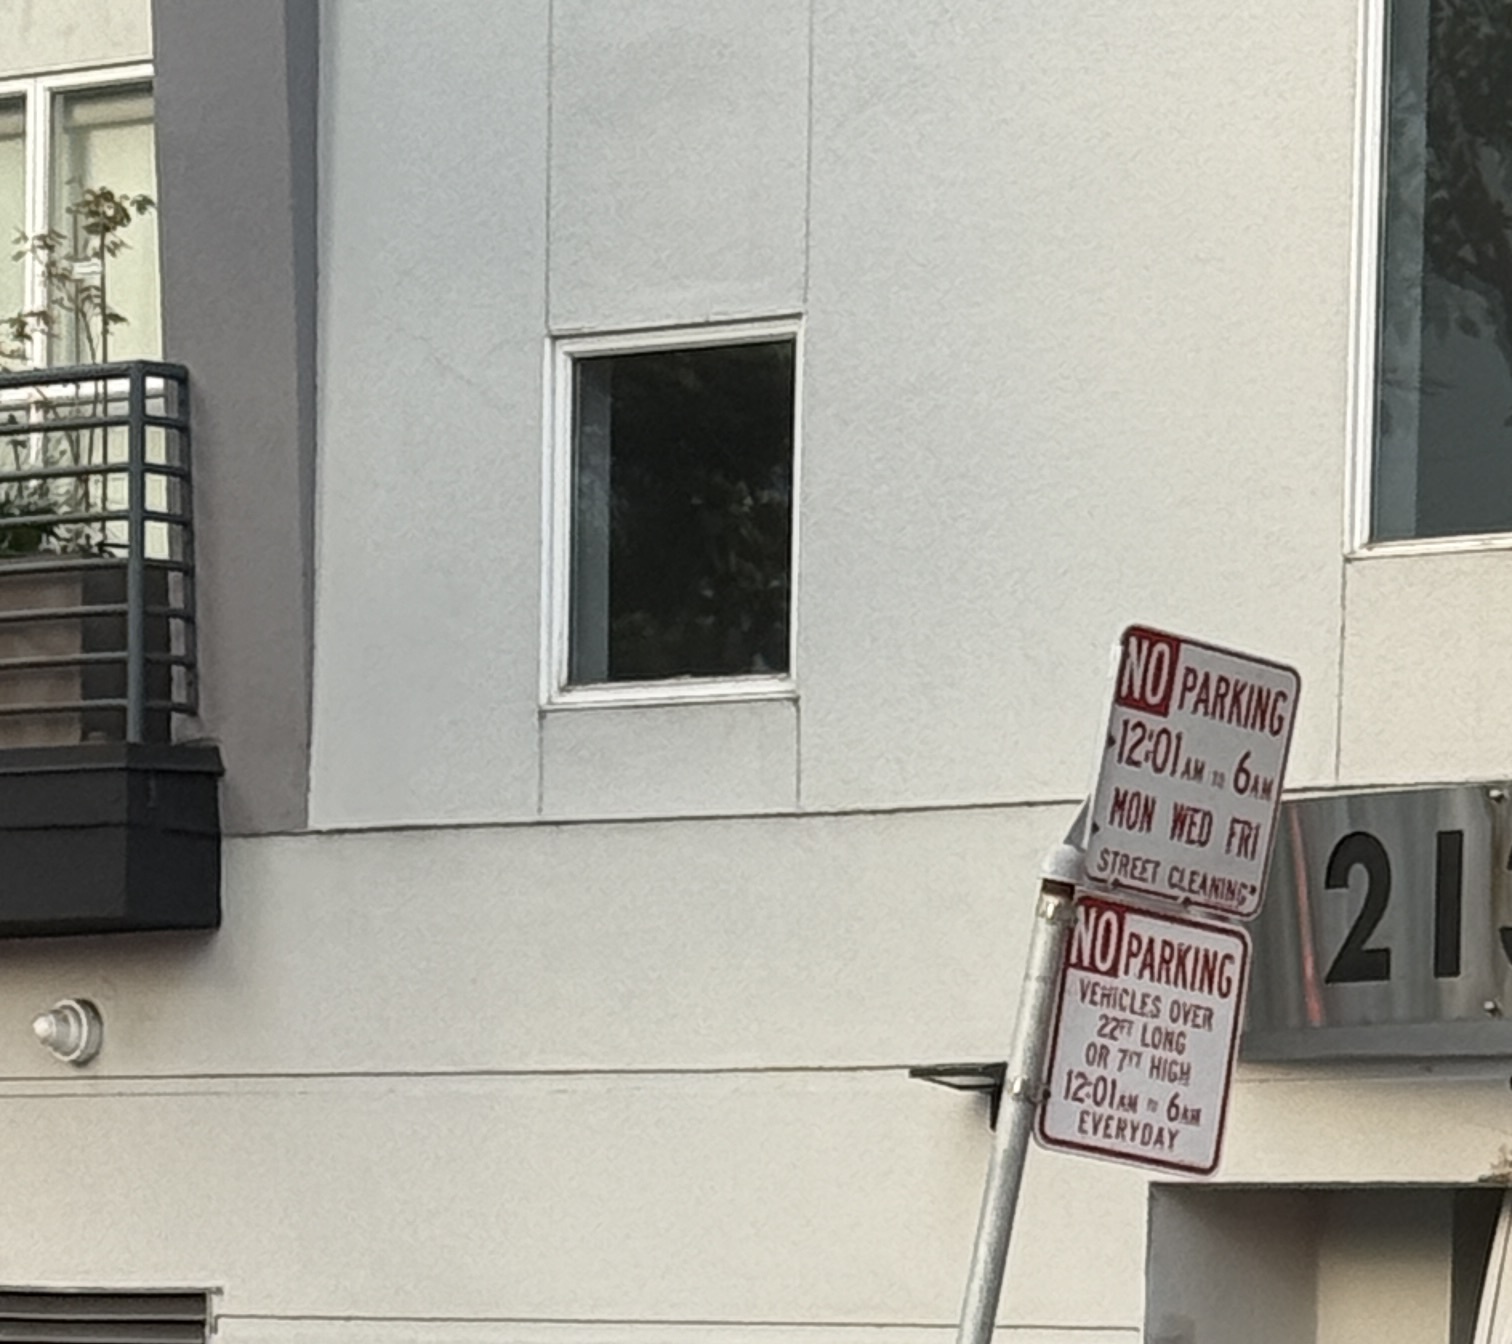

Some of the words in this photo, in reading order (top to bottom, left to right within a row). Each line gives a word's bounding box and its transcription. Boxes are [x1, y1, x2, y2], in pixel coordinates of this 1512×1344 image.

[1120, 635, 1171, 706] NO
[1177, 666, 1288, 737] PARKING
[1108, 787, 1156, 833] MON
[1170, 802, 1213, 848] WED
[1225, 817, 1260, 861] FRI
[1097, 848, 1160, 884] STREET
[1167, 866, 1252, 908] CLEANING
[1069, 906, 1119, 972] NO
[1123, 932, 1236, 999] PARKING
[1079, 979, 1161, 1019] VEHICLES
[1169, 999, 1214, 1031] OVER
[1085, 1042, 1109, 1069] OR
[1150, 1057, 1191, 1086] HIGH
[1140, 1027, 1187, 1056] LONG
[1078, 1110, 1180, 1150] EVERYDAY
